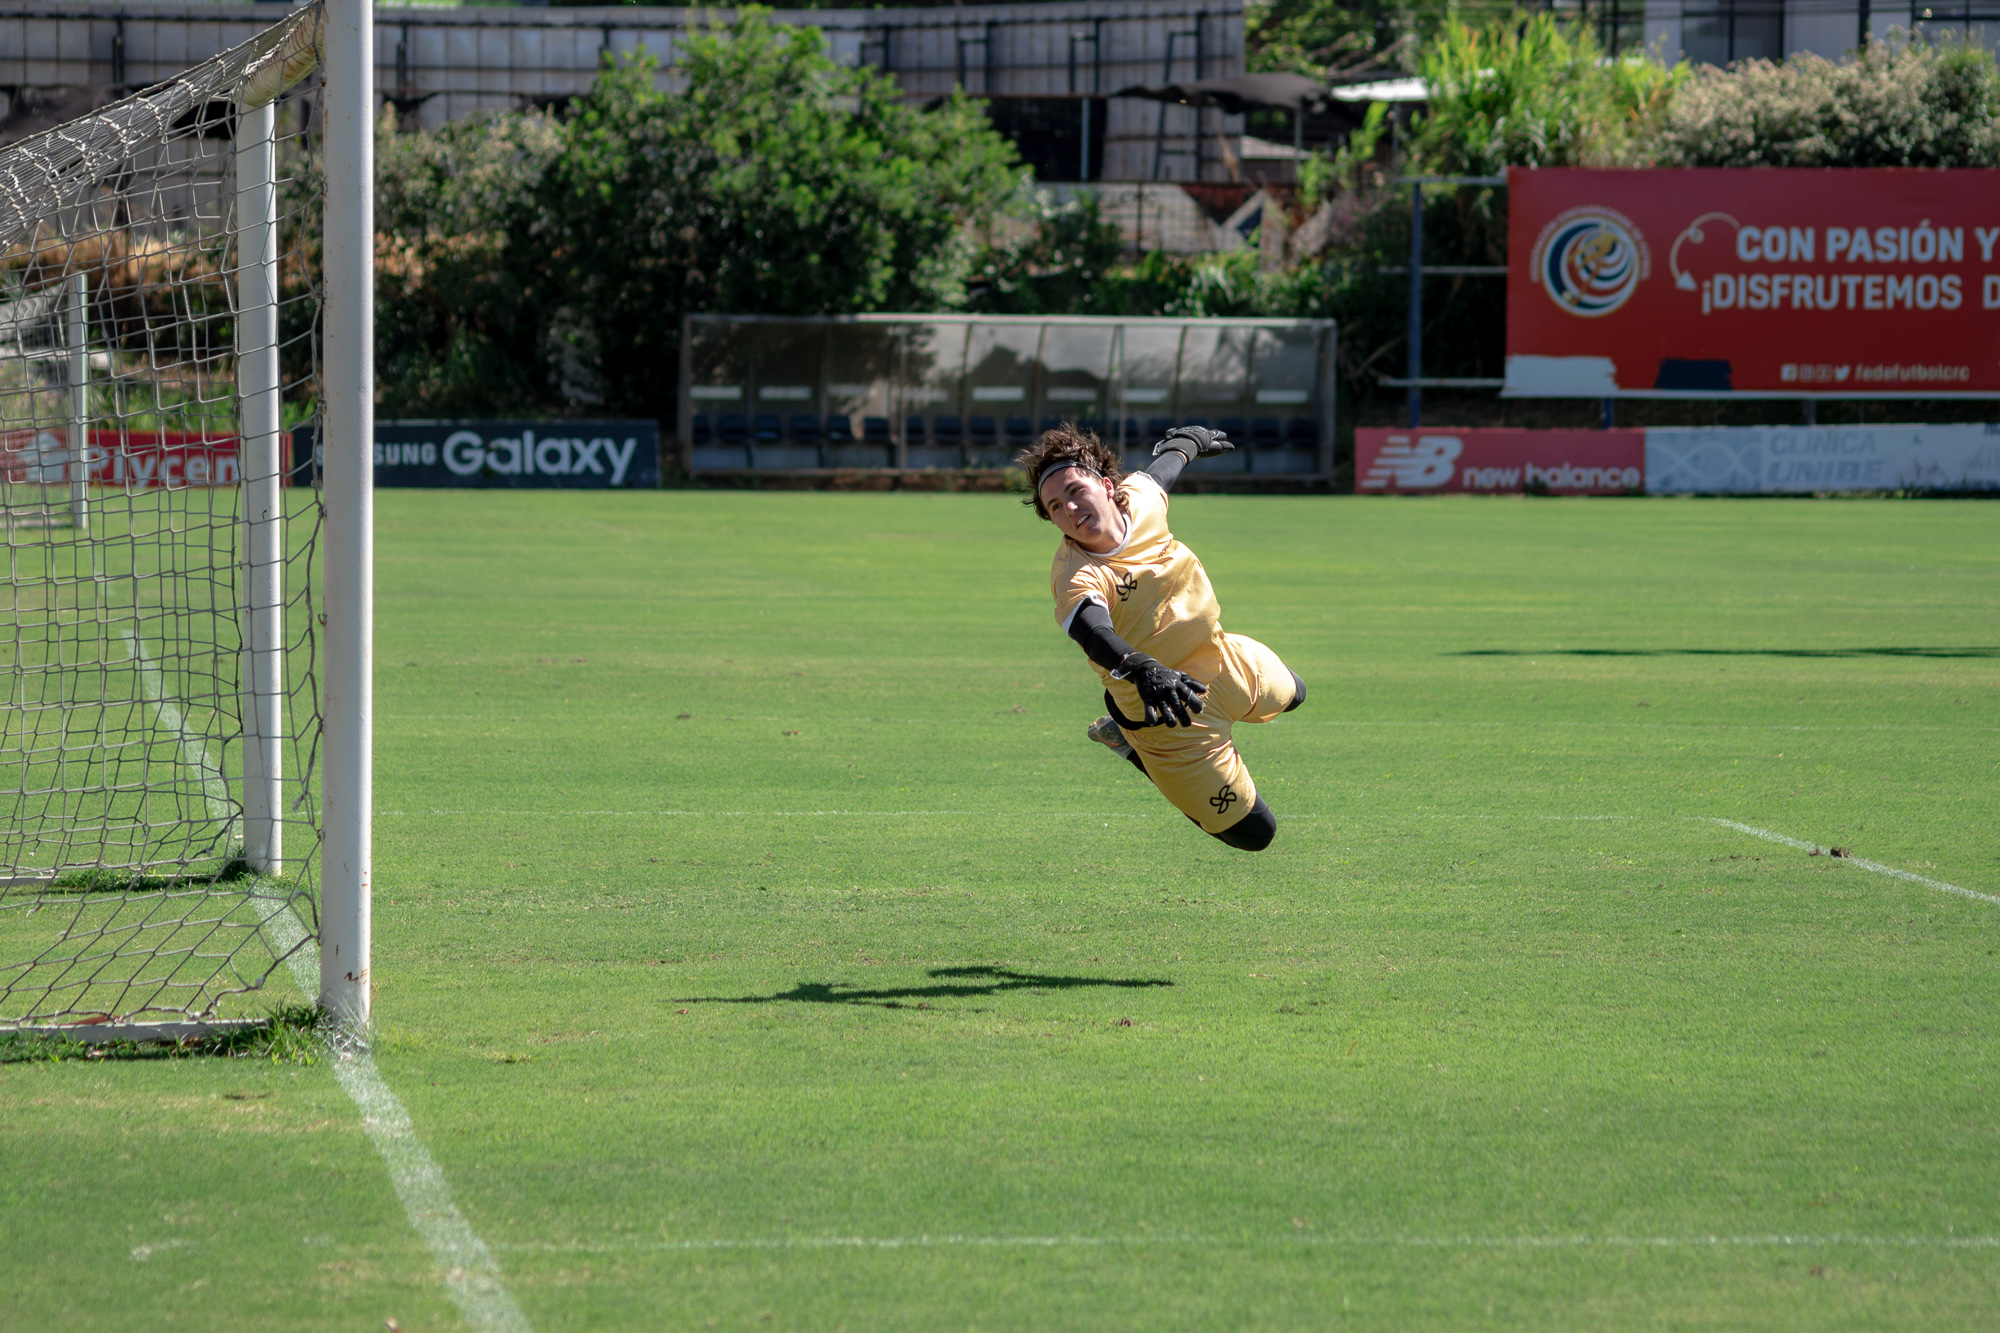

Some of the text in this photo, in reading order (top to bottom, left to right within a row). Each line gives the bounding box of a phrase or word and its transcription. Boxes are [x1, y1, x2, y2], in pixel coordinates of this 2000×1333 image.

[1736, 219, 2000, 262] CON PASIÓN Y
[1702, 273, 1963, 315] ¡DISFRUTEMOS
[443, 430, 637, 485] Galaxy
[1463, 461, 1641, 488] new balance
[1767, 459, 1885, 483] UNIBE
